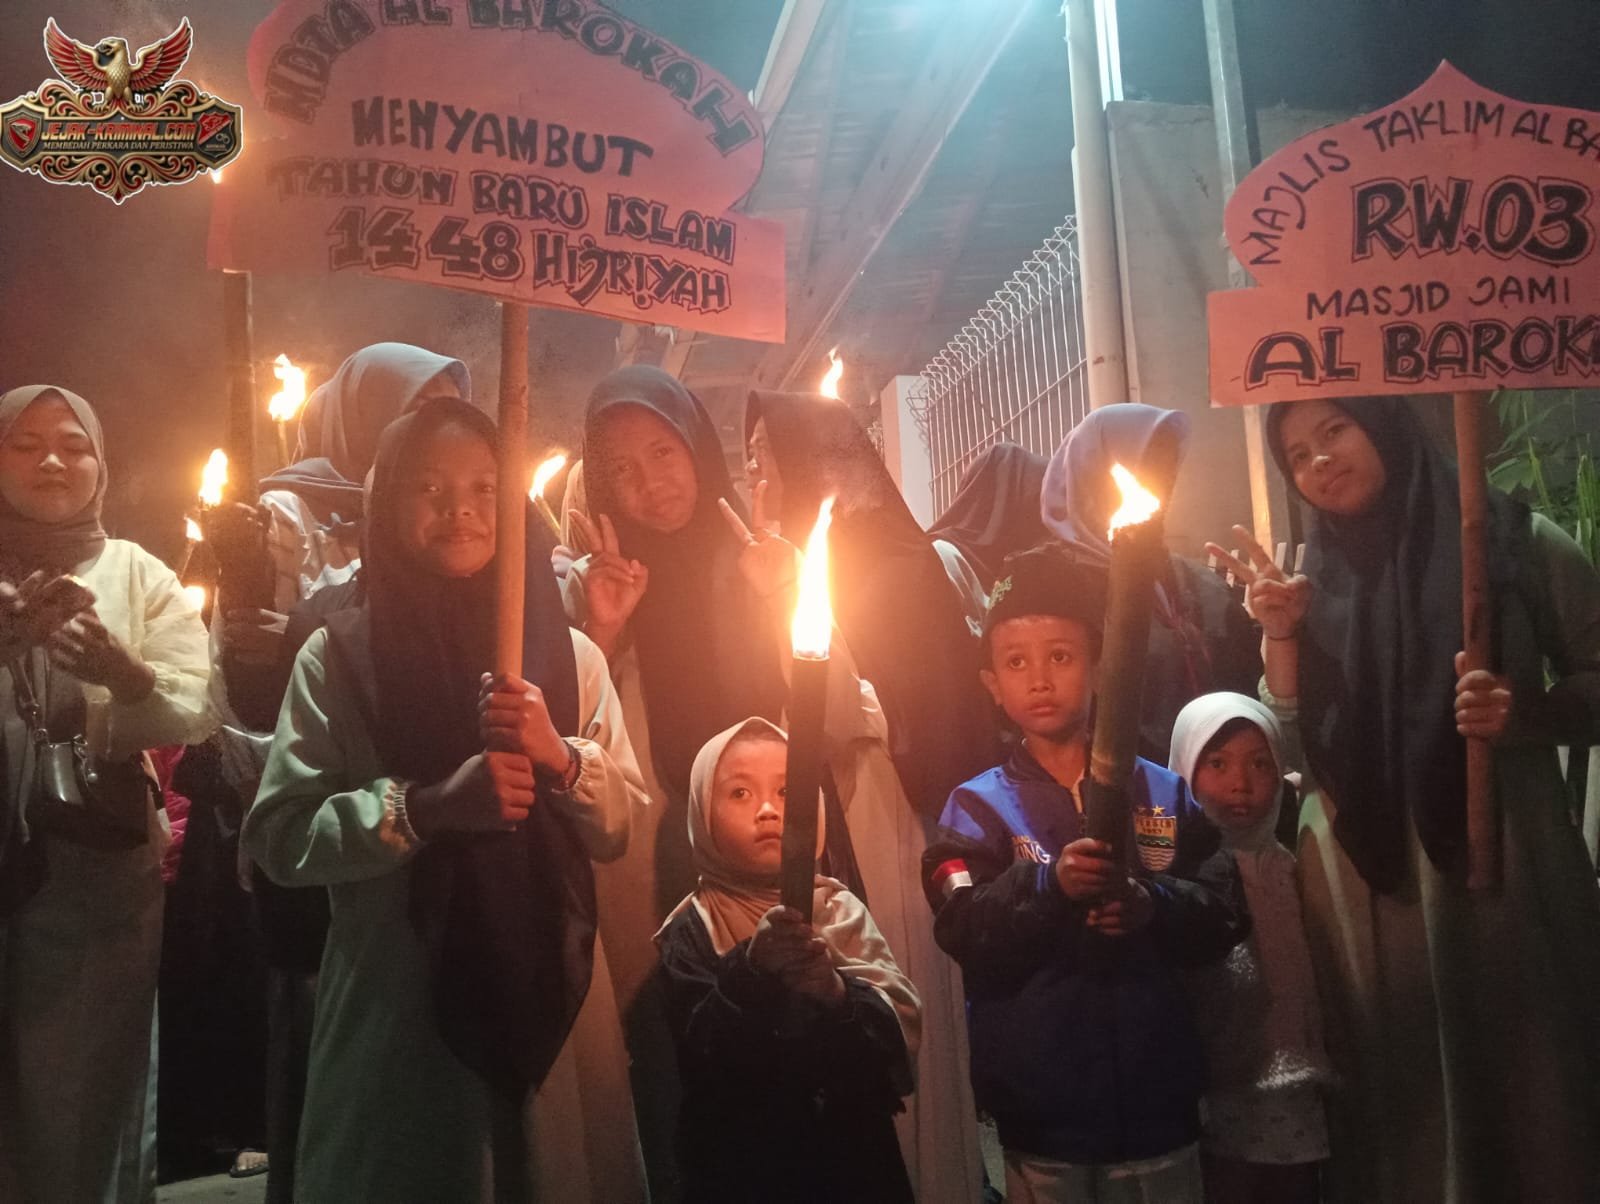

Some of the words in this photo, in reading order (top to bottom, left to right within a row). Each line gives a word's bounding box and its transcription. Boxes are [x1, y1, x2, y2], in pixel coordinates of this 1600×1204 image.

[468, 0, 760, 158] BAROKAH
[351, 96, 655, 178] MENYAMBUT
[266, 157, 458, 206] TAHUN
[470, 171, 589, 230] BARU
[605, 193, 736, 265] ISLAM
[1240, 139, 1351, 266] MAJLIS
[1362, 100, 1505, 153] TAKLIM
[1511, 108, 1553, 145] AL
[1351, 175, 1595, 268] RW.03
[532, 229, 732, 314] HIJRIYAH
[1307, 280, 1450, 320] MASJID
[1468, 275, 1570, 306] JAMI
[1244, 326, 1360, 391] AL
